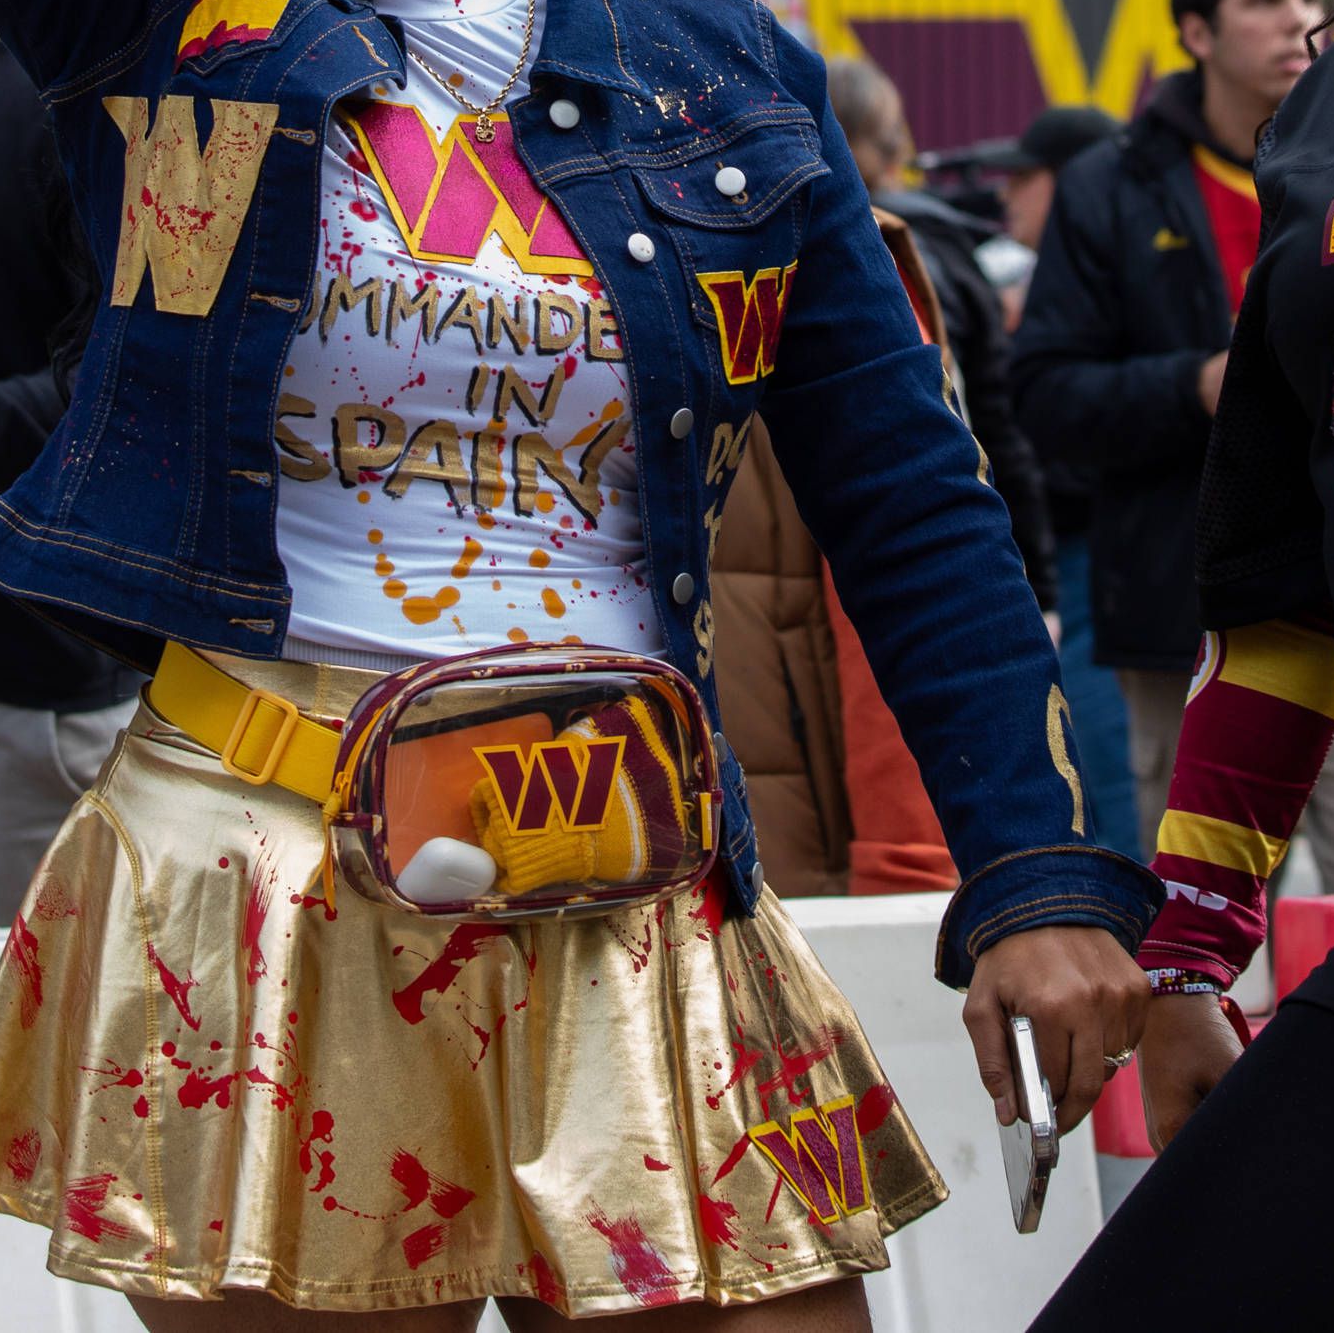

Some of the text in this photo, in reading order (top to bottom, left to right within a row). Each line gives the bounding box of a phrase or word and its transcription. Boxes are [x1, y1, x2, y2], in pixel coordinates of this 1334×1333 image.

[102, 94, 279, 318] W
[466, 362, 570, 427] IN
[275, 393, 631, 530] SPAIN
[473, 736, 627, 836] W
[747, 1094, 871, 1224] W
